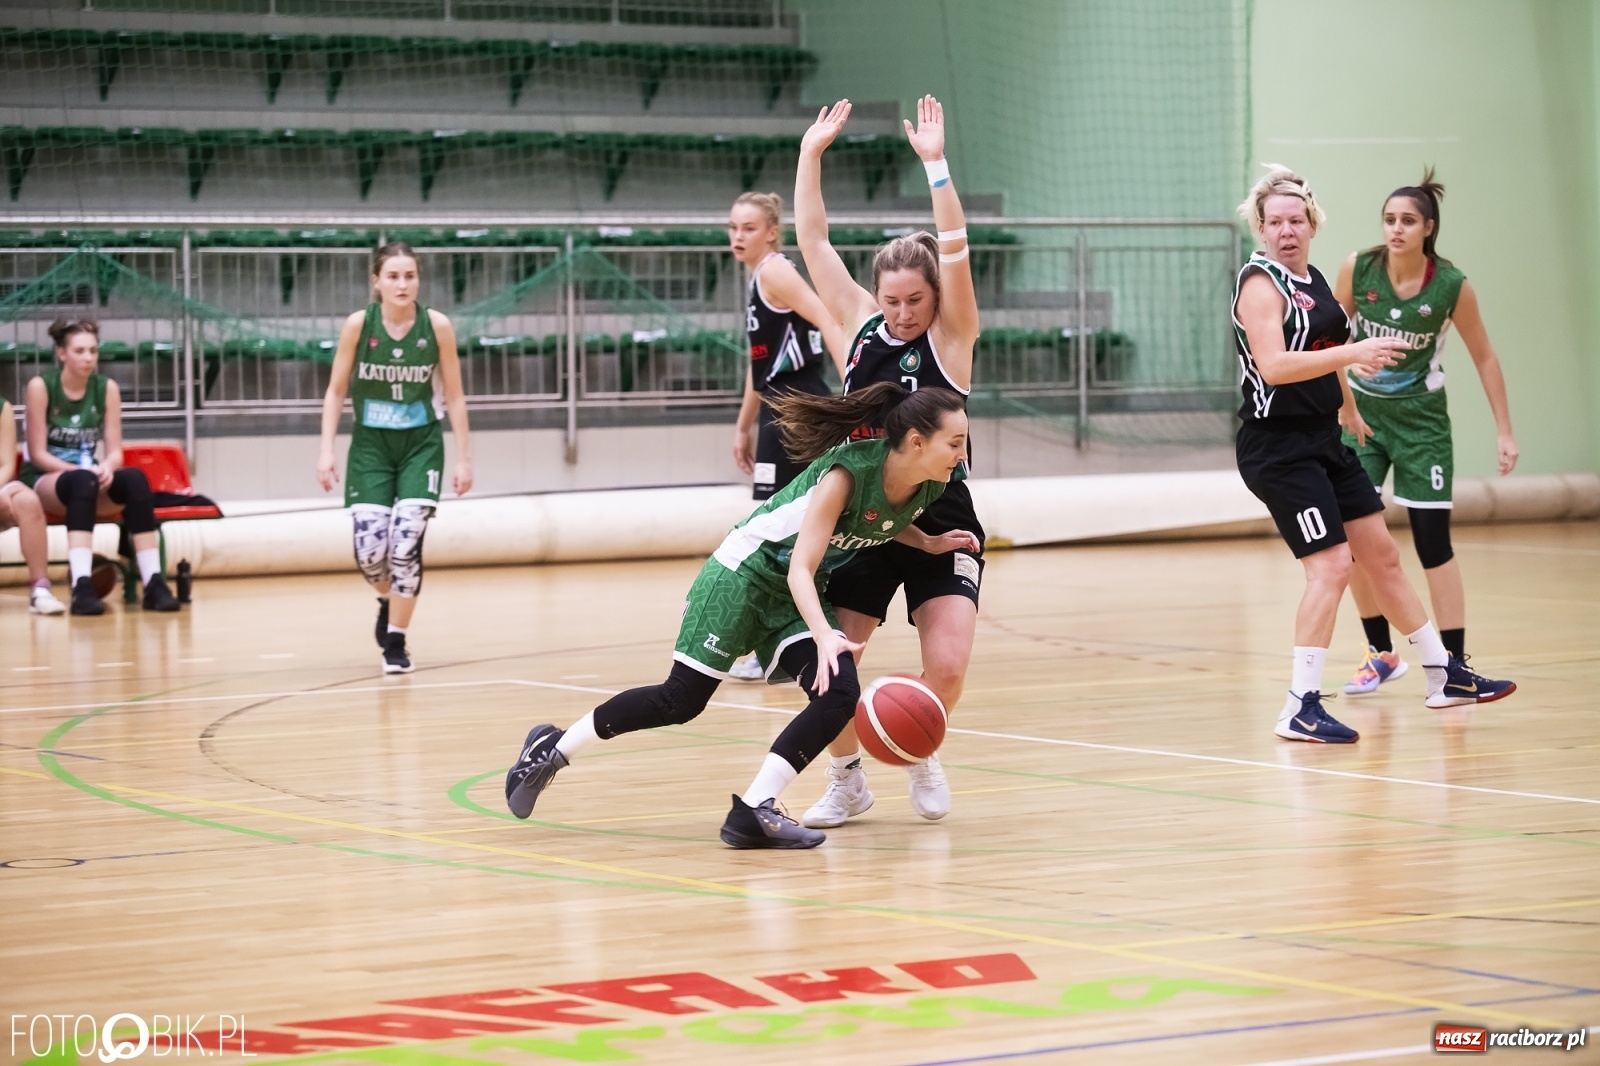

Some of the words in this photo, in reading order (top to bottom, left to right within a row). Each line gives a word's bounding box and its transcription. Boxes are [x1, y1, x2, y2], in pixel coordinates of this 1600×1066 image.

[358, 362, 434, 383] KATOWIC
[391, 383, 404, 401] 11
[426, 468, 440, 495] 11
[1430, 464, 1444, 491] 6
[1296, 506, 1328, 544] 10
